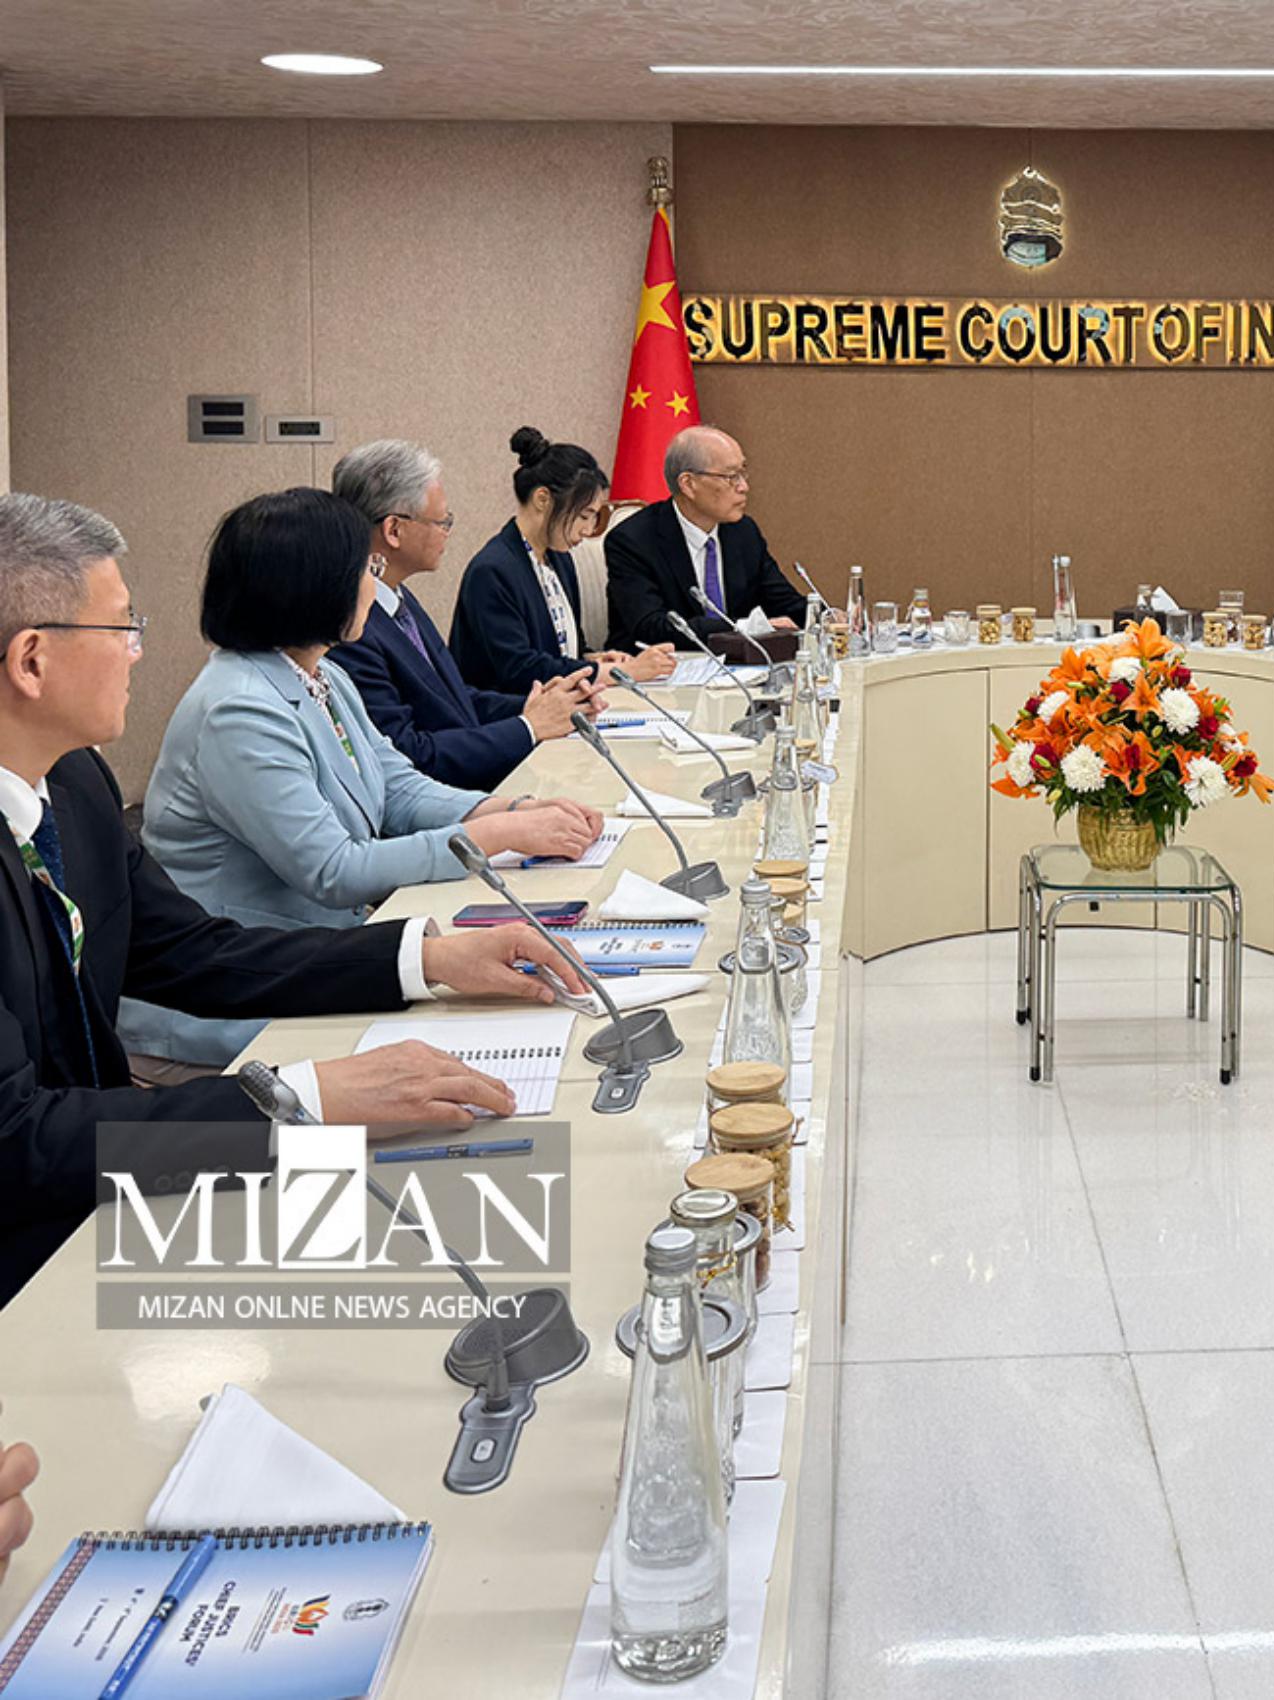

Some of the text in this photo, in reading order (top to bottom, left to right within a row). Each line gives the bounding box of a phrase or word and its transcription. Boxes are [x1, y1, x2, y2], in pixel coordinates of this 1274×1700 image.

[683, 300, 946, 362] SUPREME
[960, 303, 1144, 363] COURT
[1153, 304, 1220, 363] OF
[213, 1580, 236, 1612] CHIEF
[179, 1604, 209, 1642] FORUM
[215, 1605, 240, 1638] BRICS
